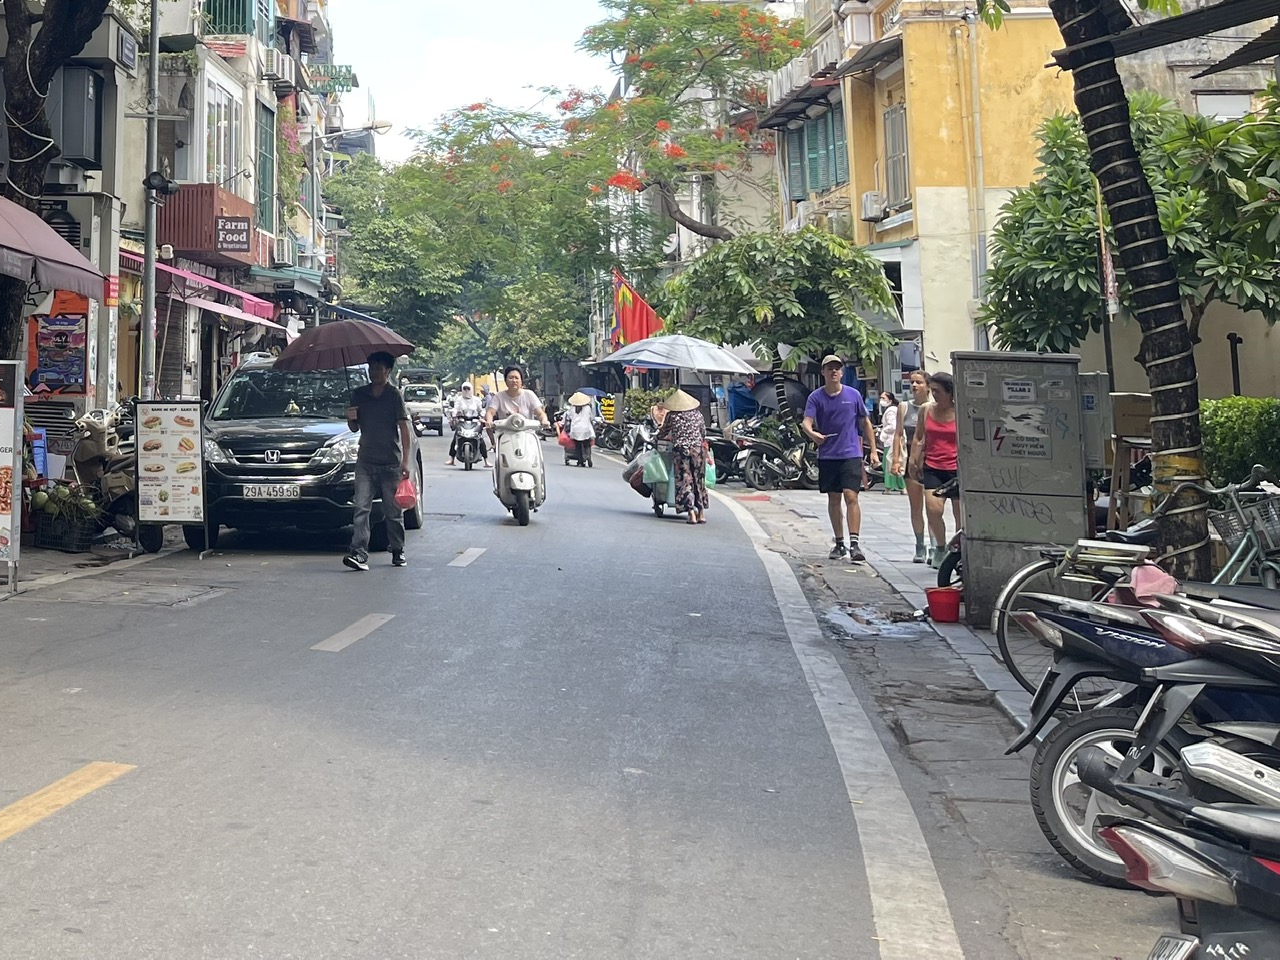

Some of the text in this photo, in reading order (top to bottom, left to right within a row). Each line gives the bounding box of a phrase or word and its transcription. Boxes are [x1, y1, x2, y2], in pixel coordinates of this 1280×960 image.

[308, 65, 352, 77] GARDEN
[217, 219, 248, 230] Farm
[218, 230, 247, 242] Food
[1094, 626, 1166, 649] VISION
